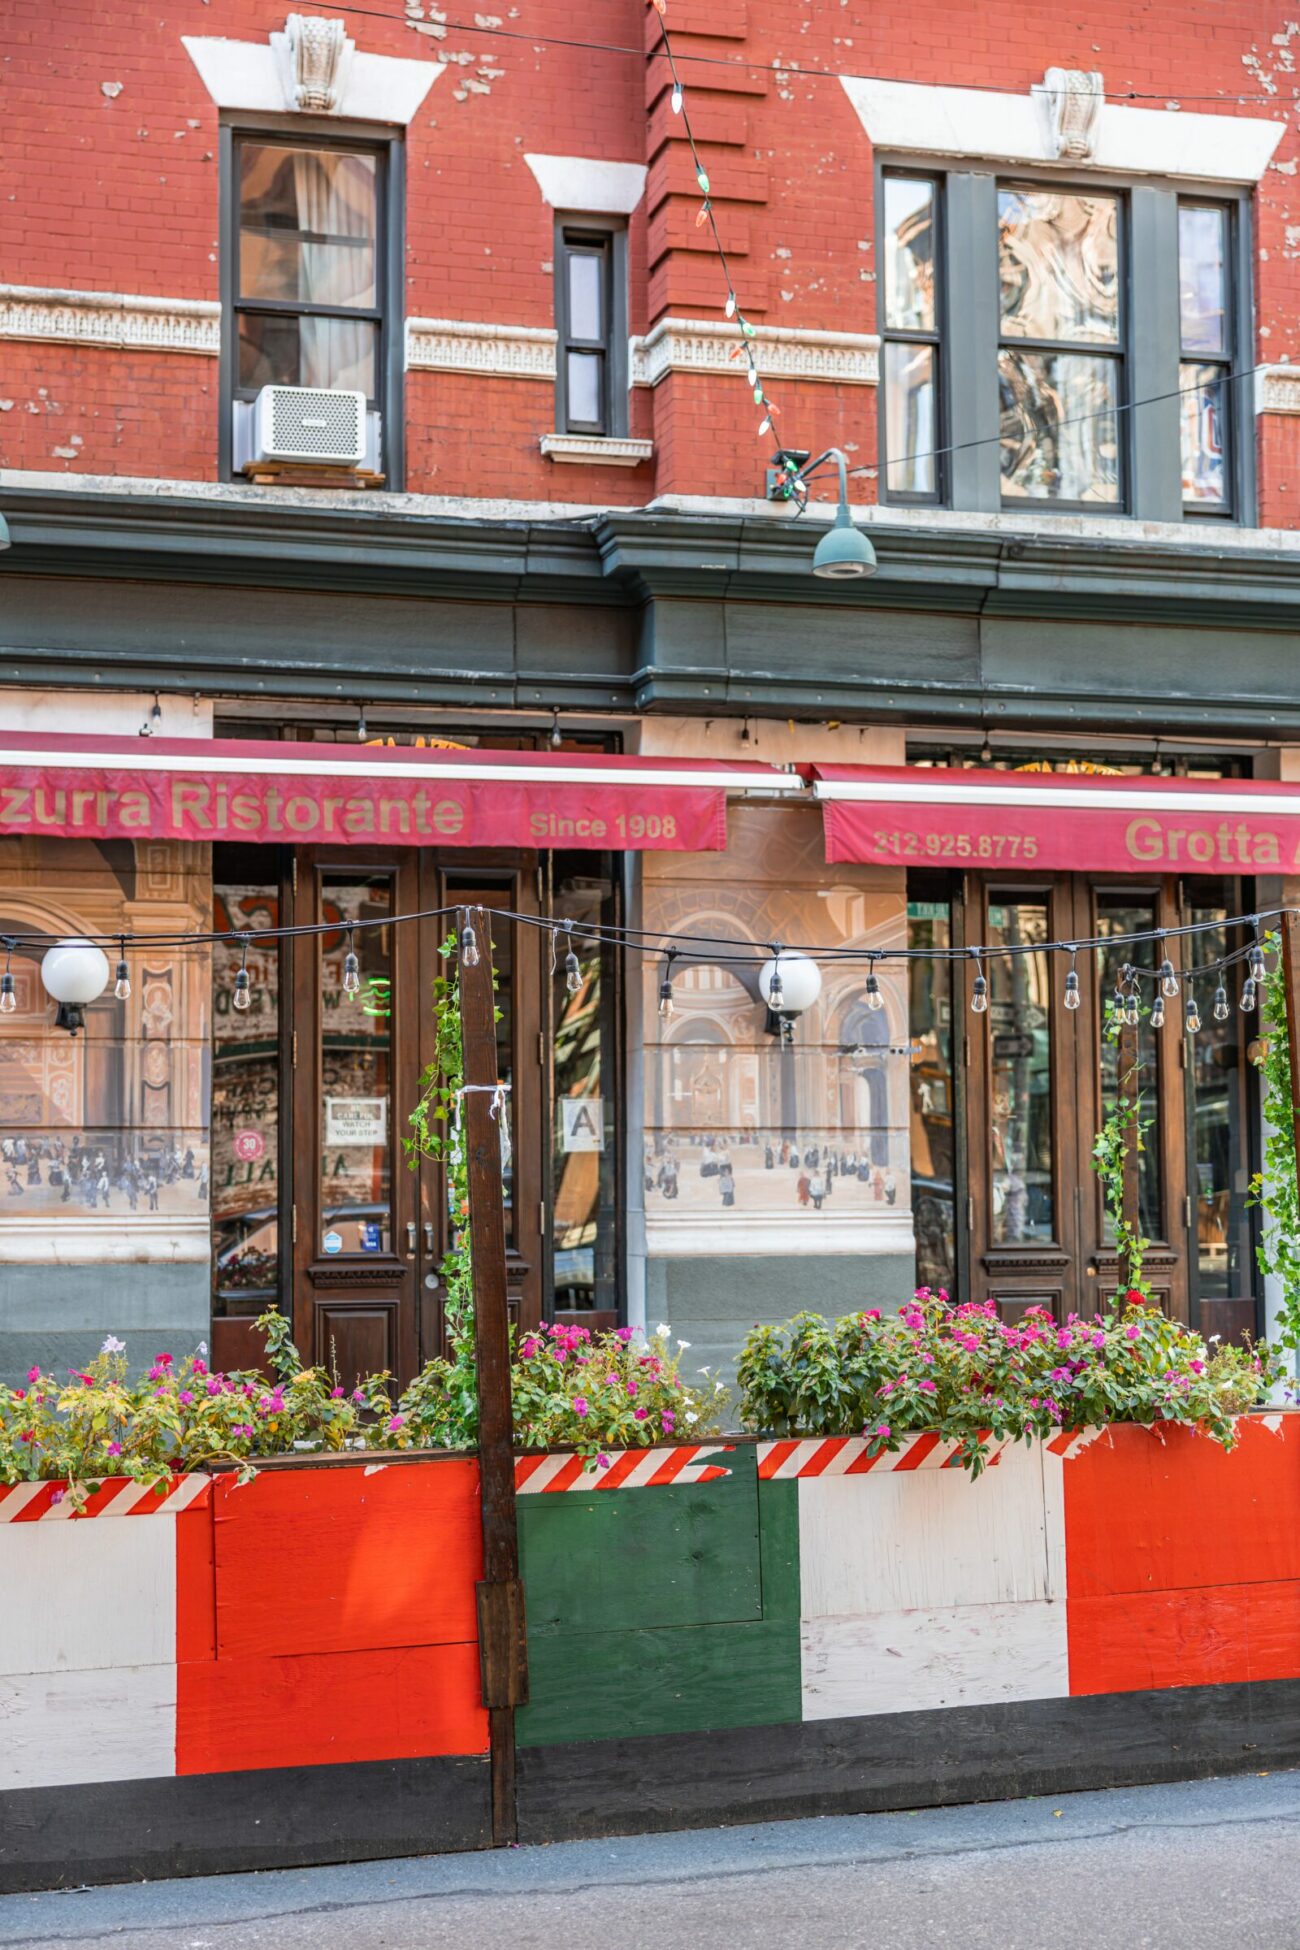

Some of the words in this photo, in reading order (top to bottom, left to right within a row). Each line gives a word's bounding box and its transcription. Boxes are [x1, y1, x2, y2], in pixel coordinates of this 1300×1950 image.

[0, 788, 151, 827] zurra
[171, 780, 464, 834] Ristorante
[529, 812, 608, 838] Since
[615, 814, 677, 840] 1908
[1125, 817, 1281, 865] Grotta
[873, 831, 1038, 859] 212.925.8775
[335, 1129, 357, 1137] YOUR
[359, 1129, 378, 1137] STEP
[570, 1105, 598, 1137] A
